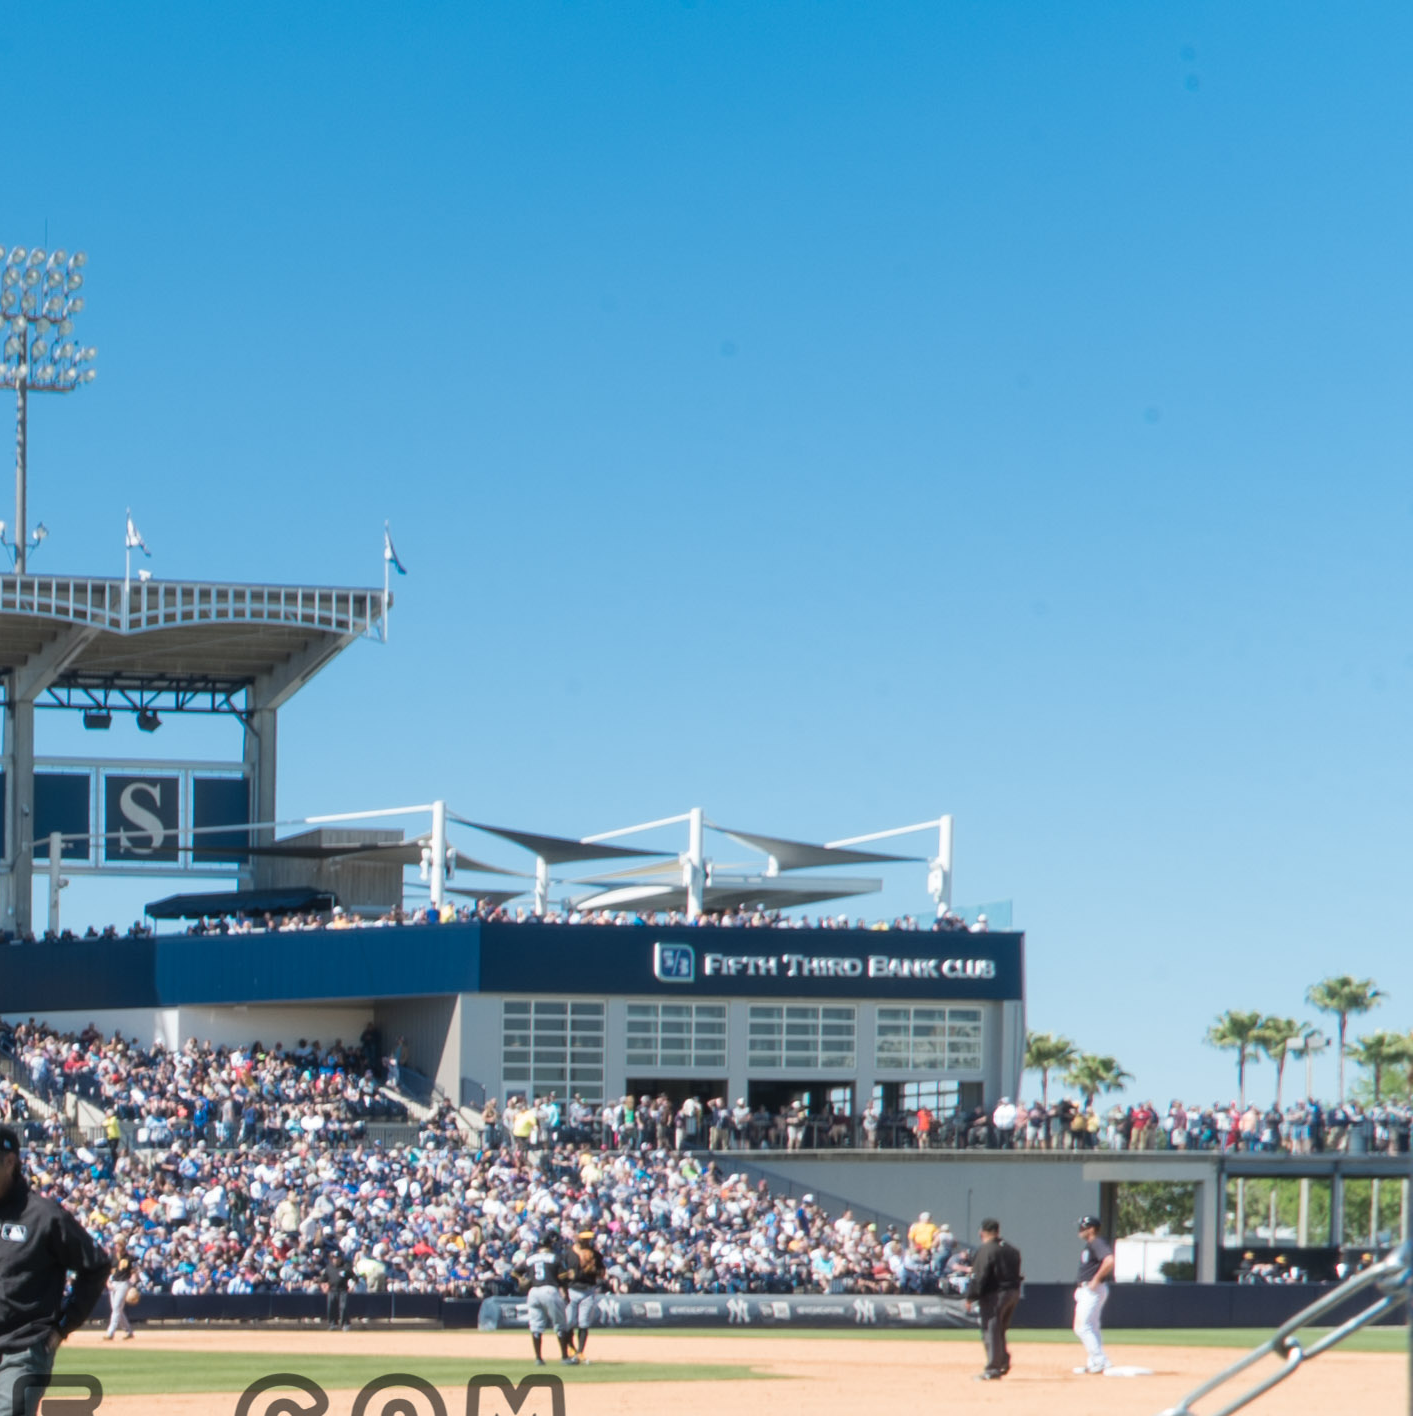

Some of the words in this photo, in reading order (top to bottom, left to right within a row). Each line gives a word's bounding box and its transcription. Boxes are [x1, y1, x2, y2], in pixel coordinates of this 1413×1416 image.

[704, 952, 778, 977] FIFTH
[782, 953, 863, 978] THIRD
[867, 954, 938, 978] BANK
